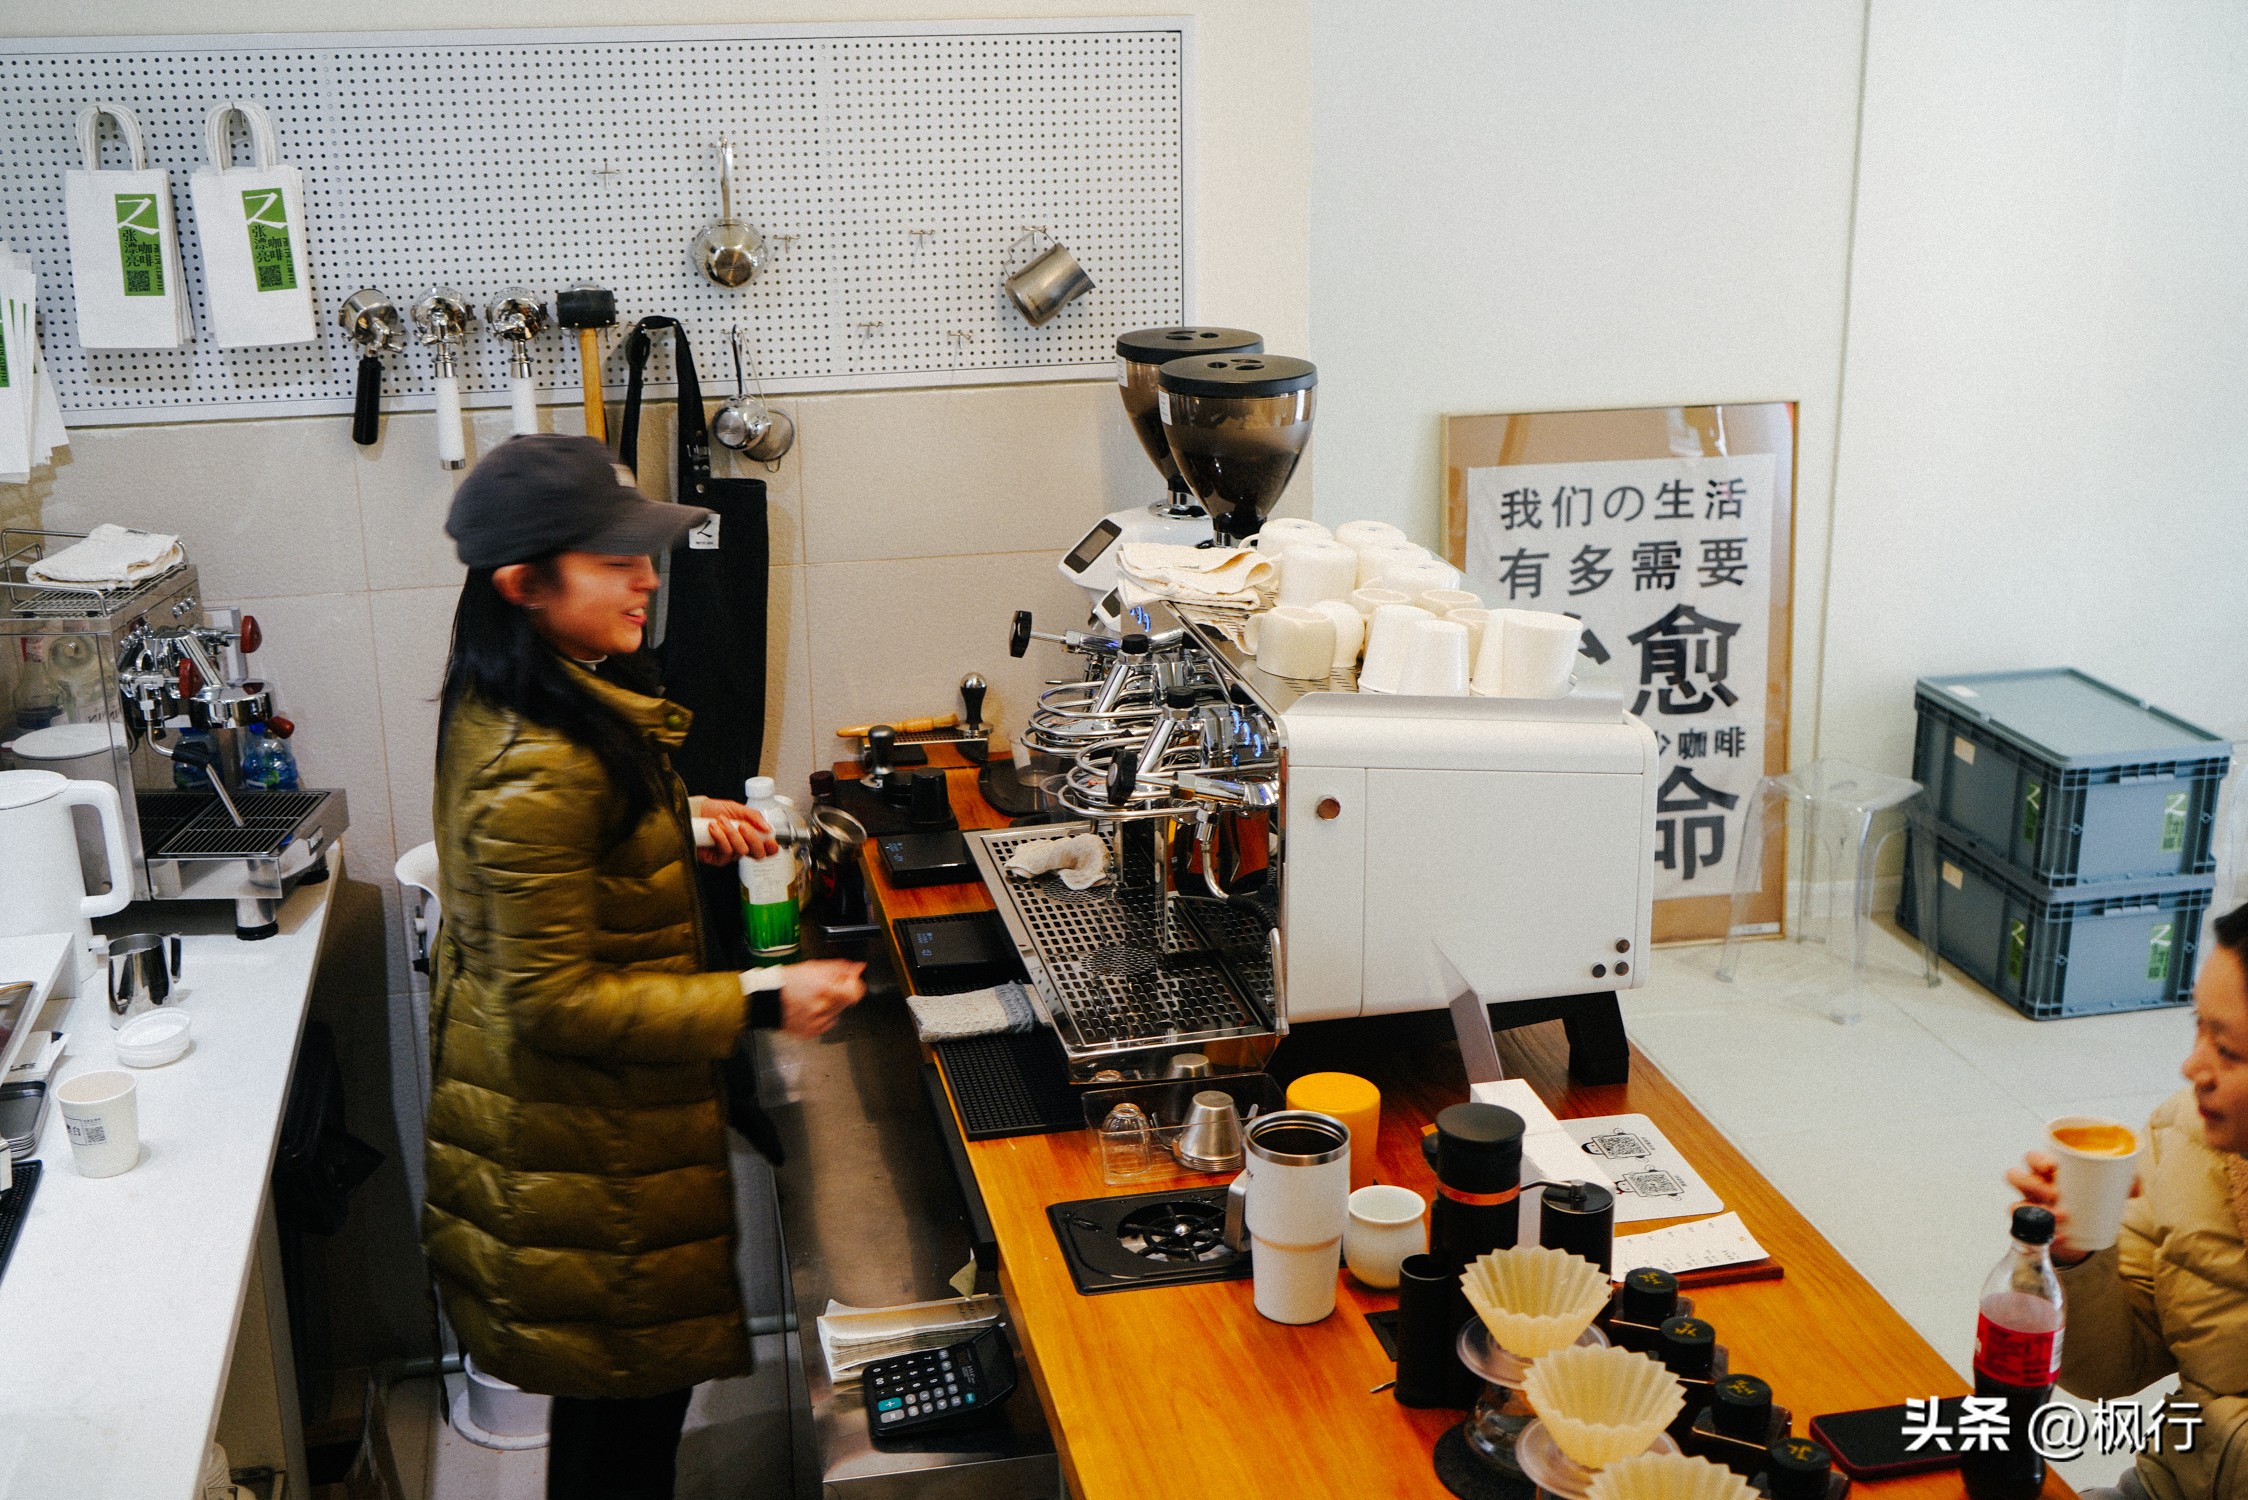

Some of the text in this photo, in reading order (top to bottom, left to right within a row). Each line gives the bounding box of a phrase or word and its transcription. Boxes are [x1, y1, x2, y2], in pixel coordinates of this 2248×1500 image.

[1500, 477, 1748, 531] 我们の生活
[1498, 536, 1749, 601] 有多需要
[1562, 603, 1742, 717] 愈
